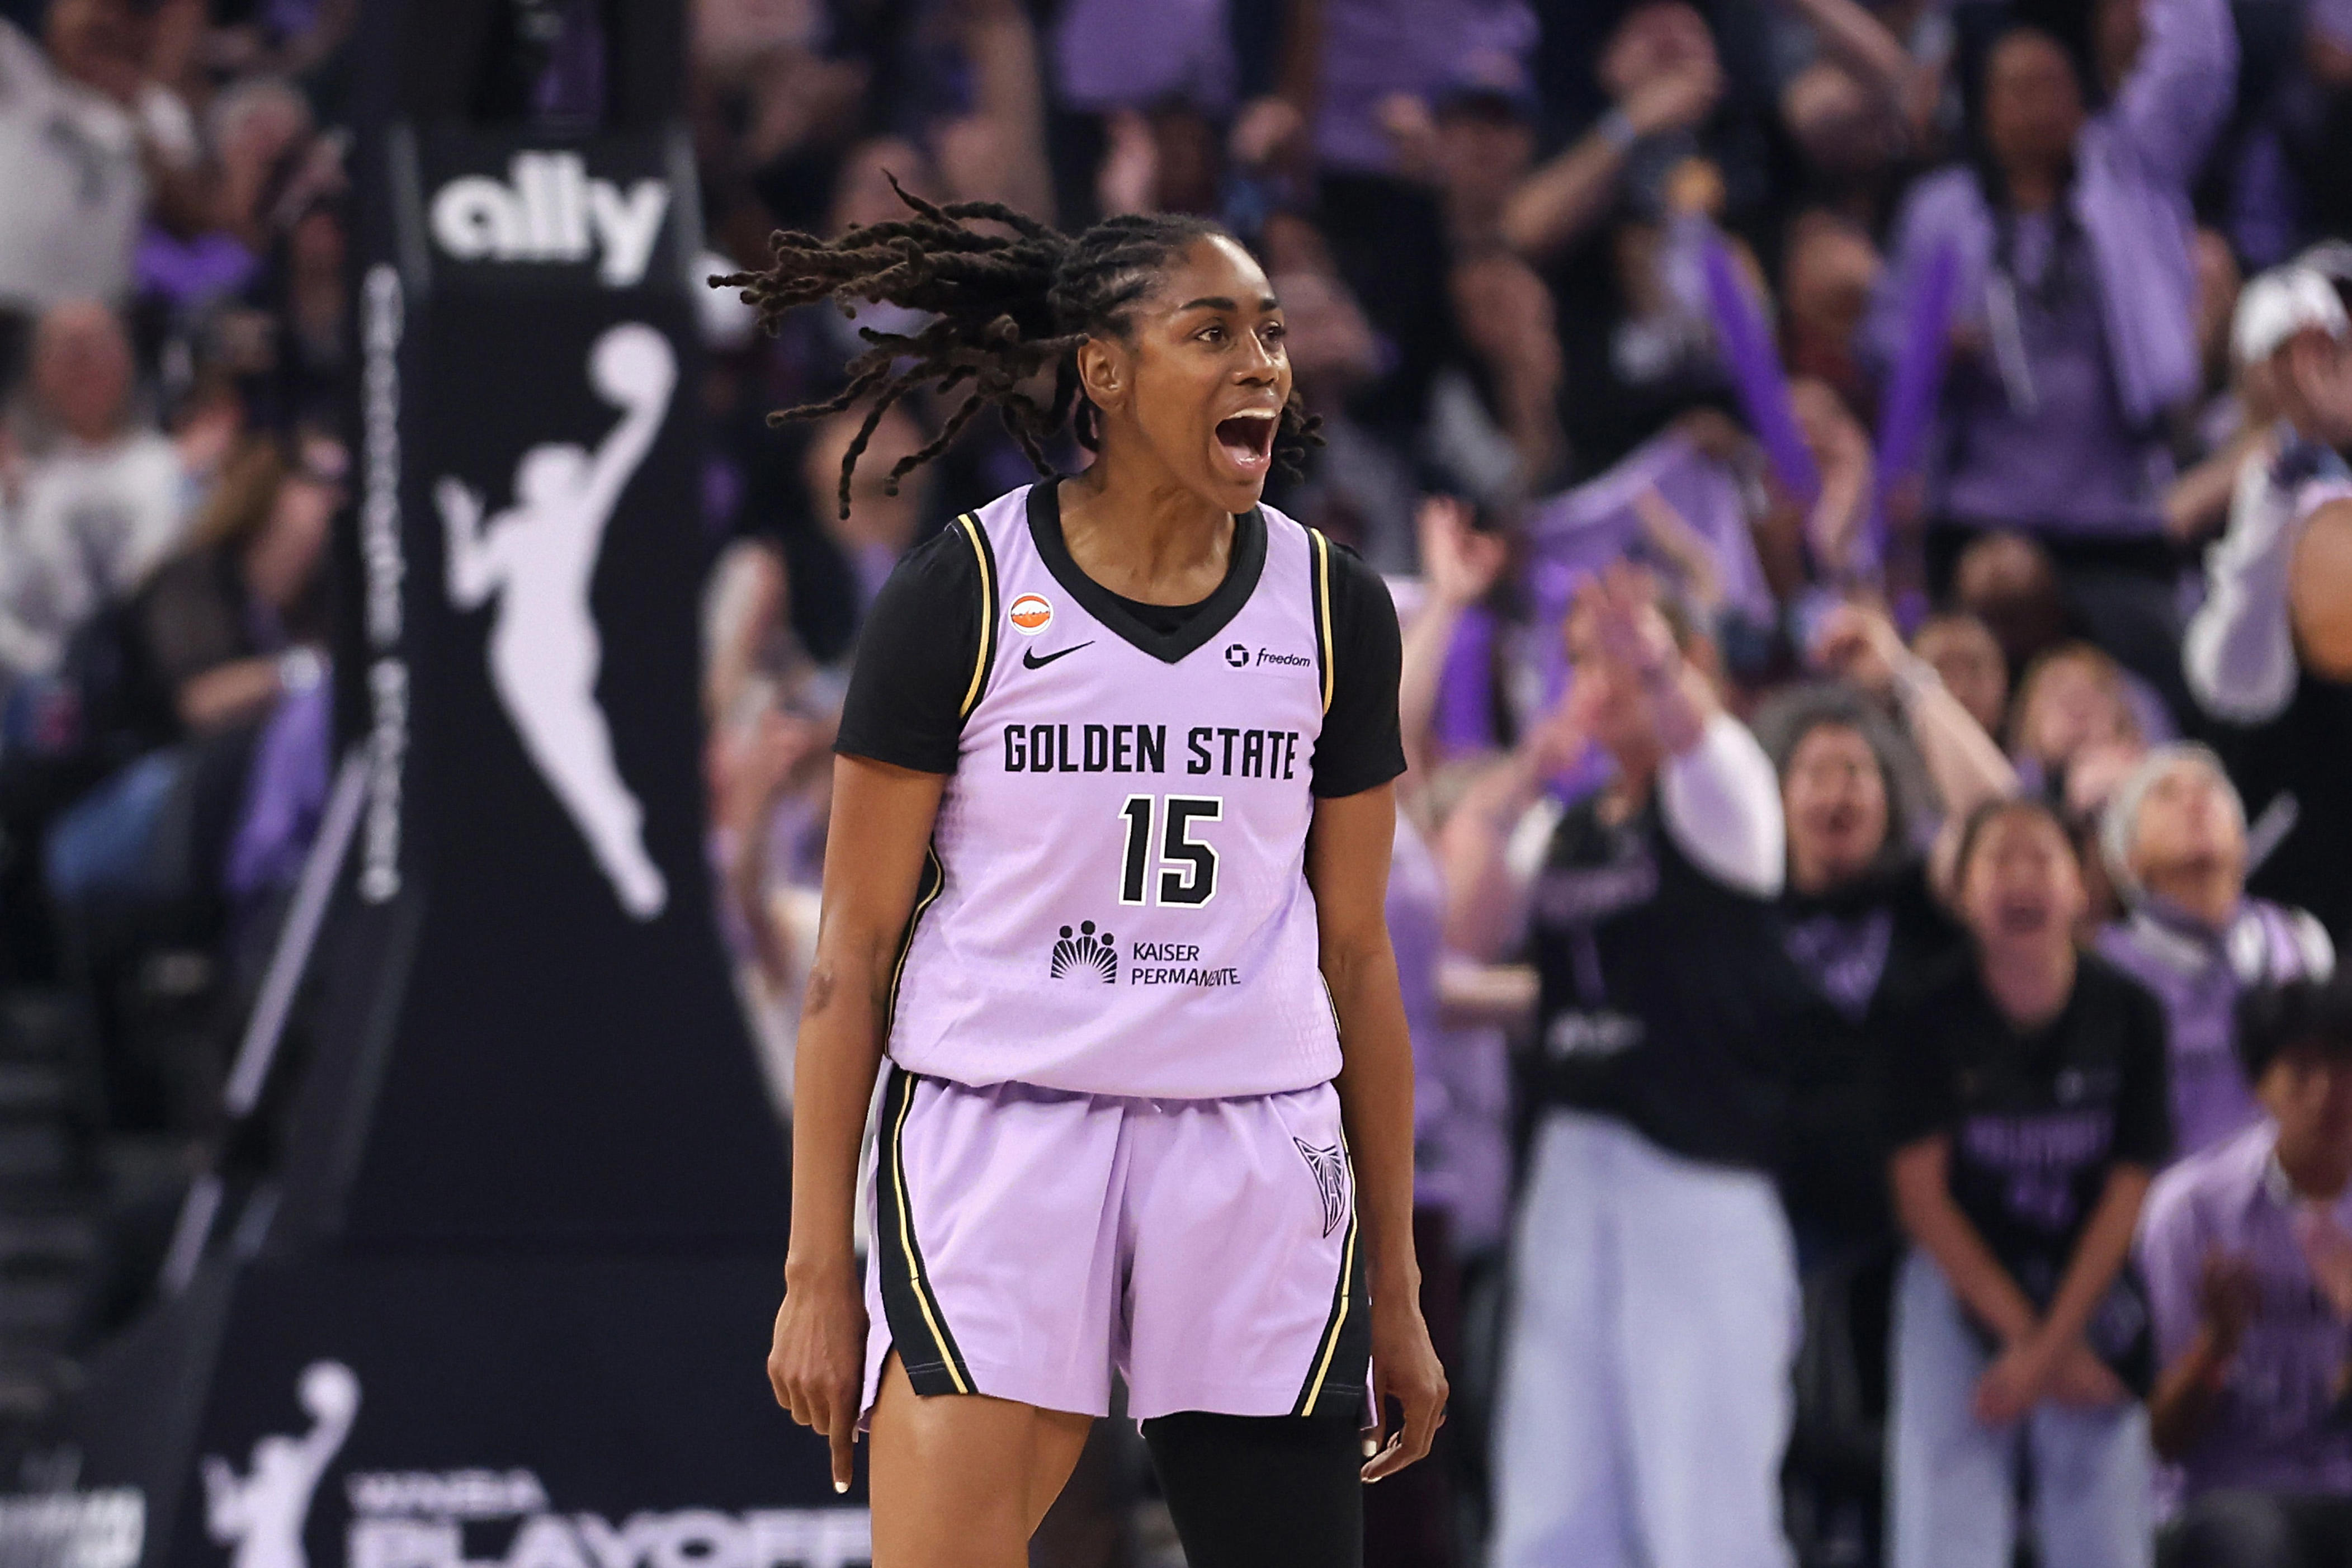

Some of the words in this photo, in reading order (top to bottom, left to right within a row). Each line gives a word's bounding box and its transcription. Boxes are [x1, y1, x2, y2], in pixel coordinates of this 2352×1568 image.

[431, 151, 670, 287] ally
[1256, 648, 1311, 667] freedom
[1004, 724, 1166, 773] GOLDEN
[1187, 727, 1300, 781] STATE
[1119, 794, 1223, 908] 15
[1133, 942, 1200, 961] KAISER
